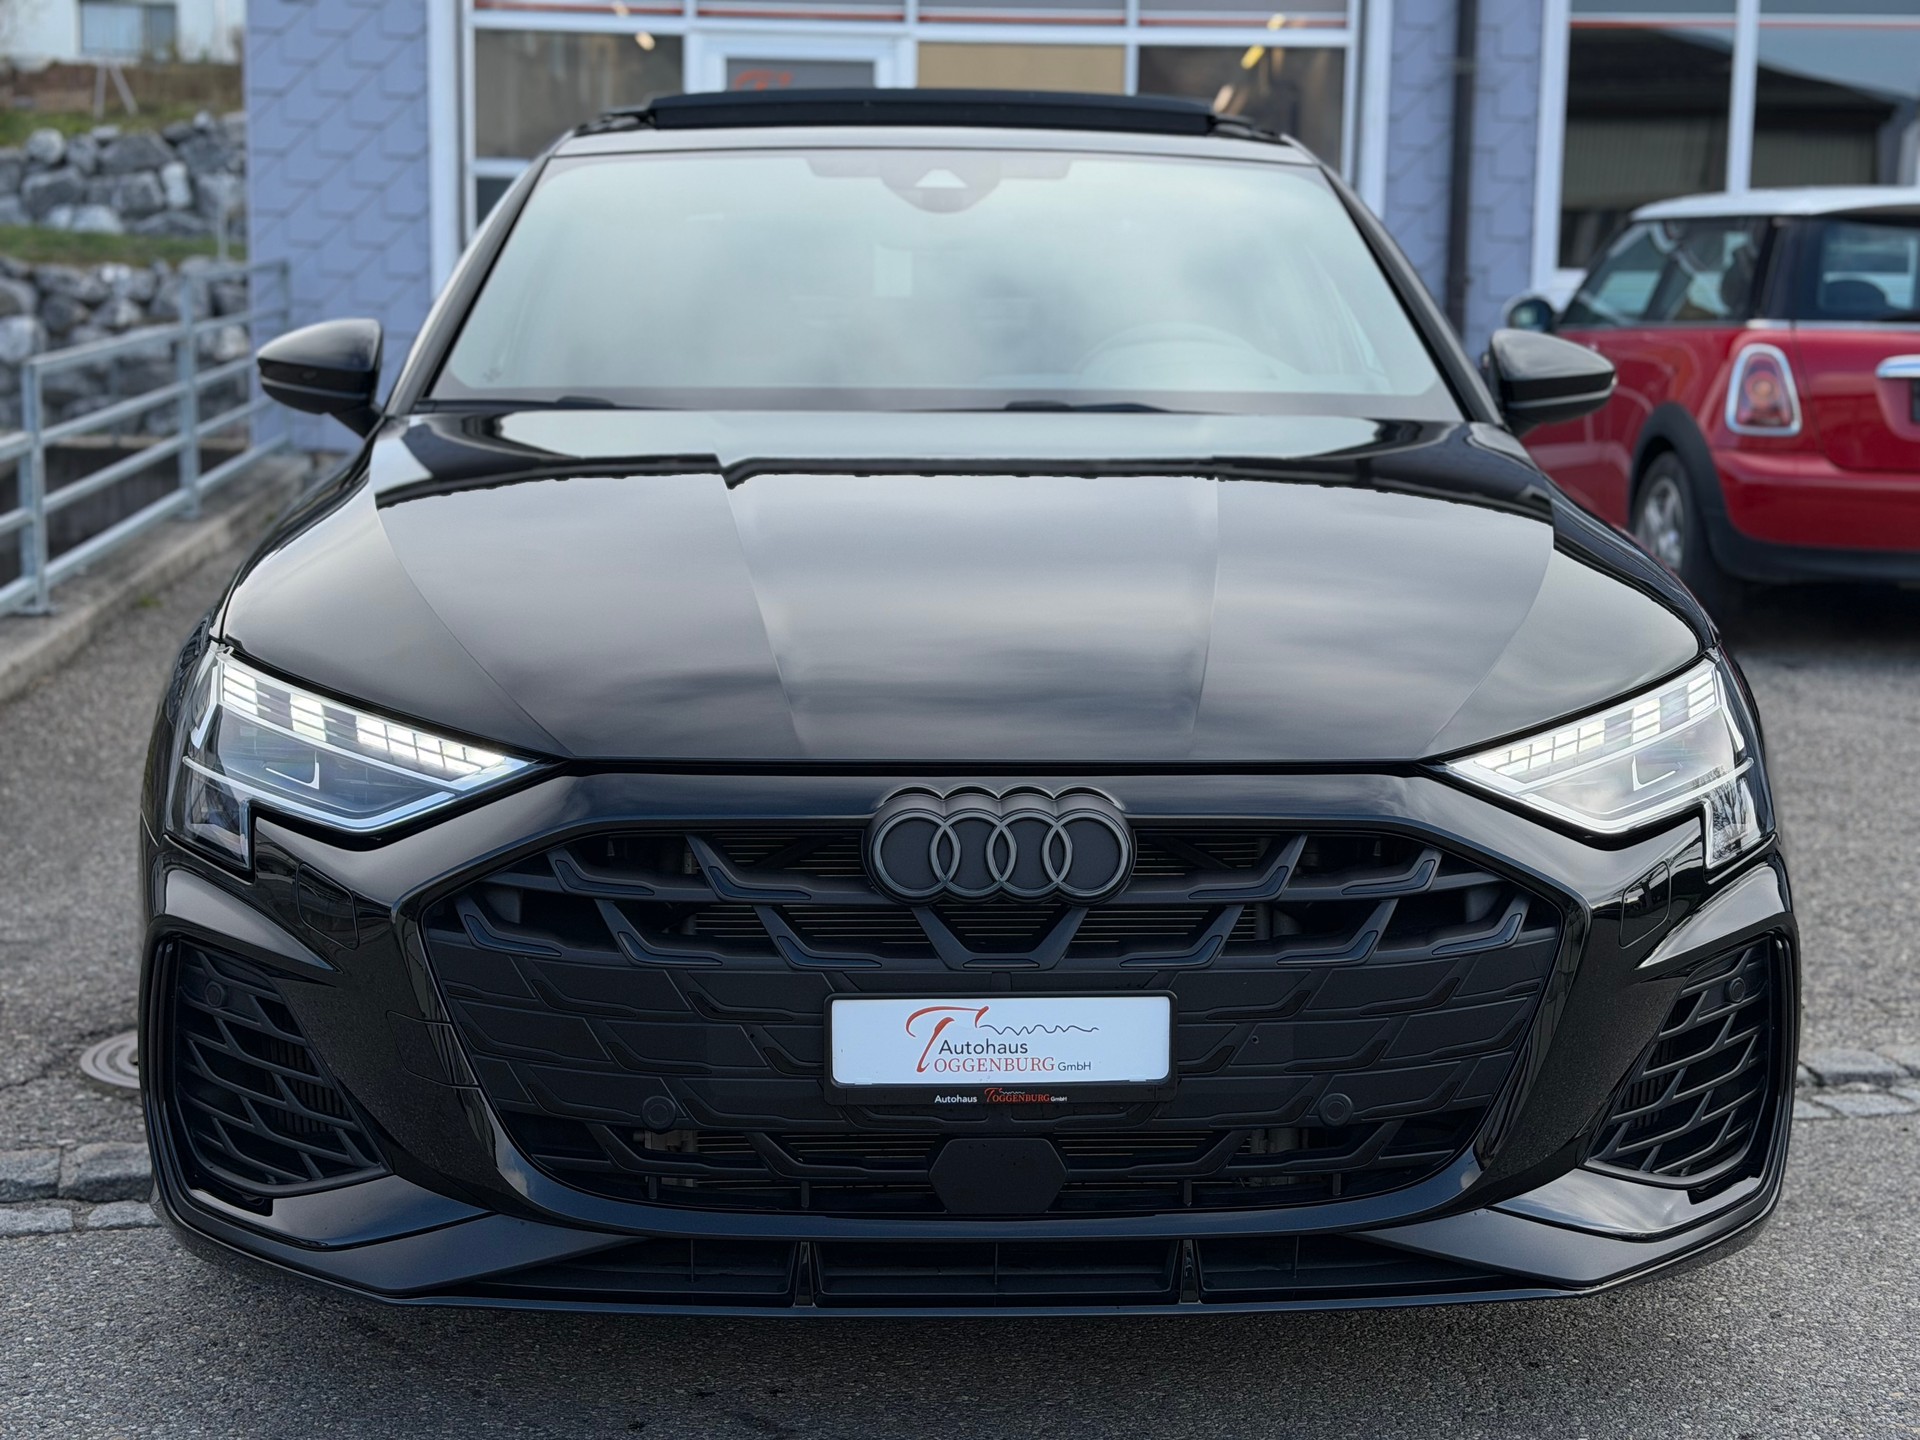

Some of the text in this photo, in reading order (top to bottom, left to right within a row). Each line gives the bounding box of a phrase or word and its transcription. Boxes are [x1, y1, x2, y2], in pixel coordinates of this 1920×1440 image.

[906, 1006, 1092, 1073] TOGGENBURG GmbH
[938, 1038, 1028, 1055] Autohaus
[934, 1094, 978, 1104] Autohaus
